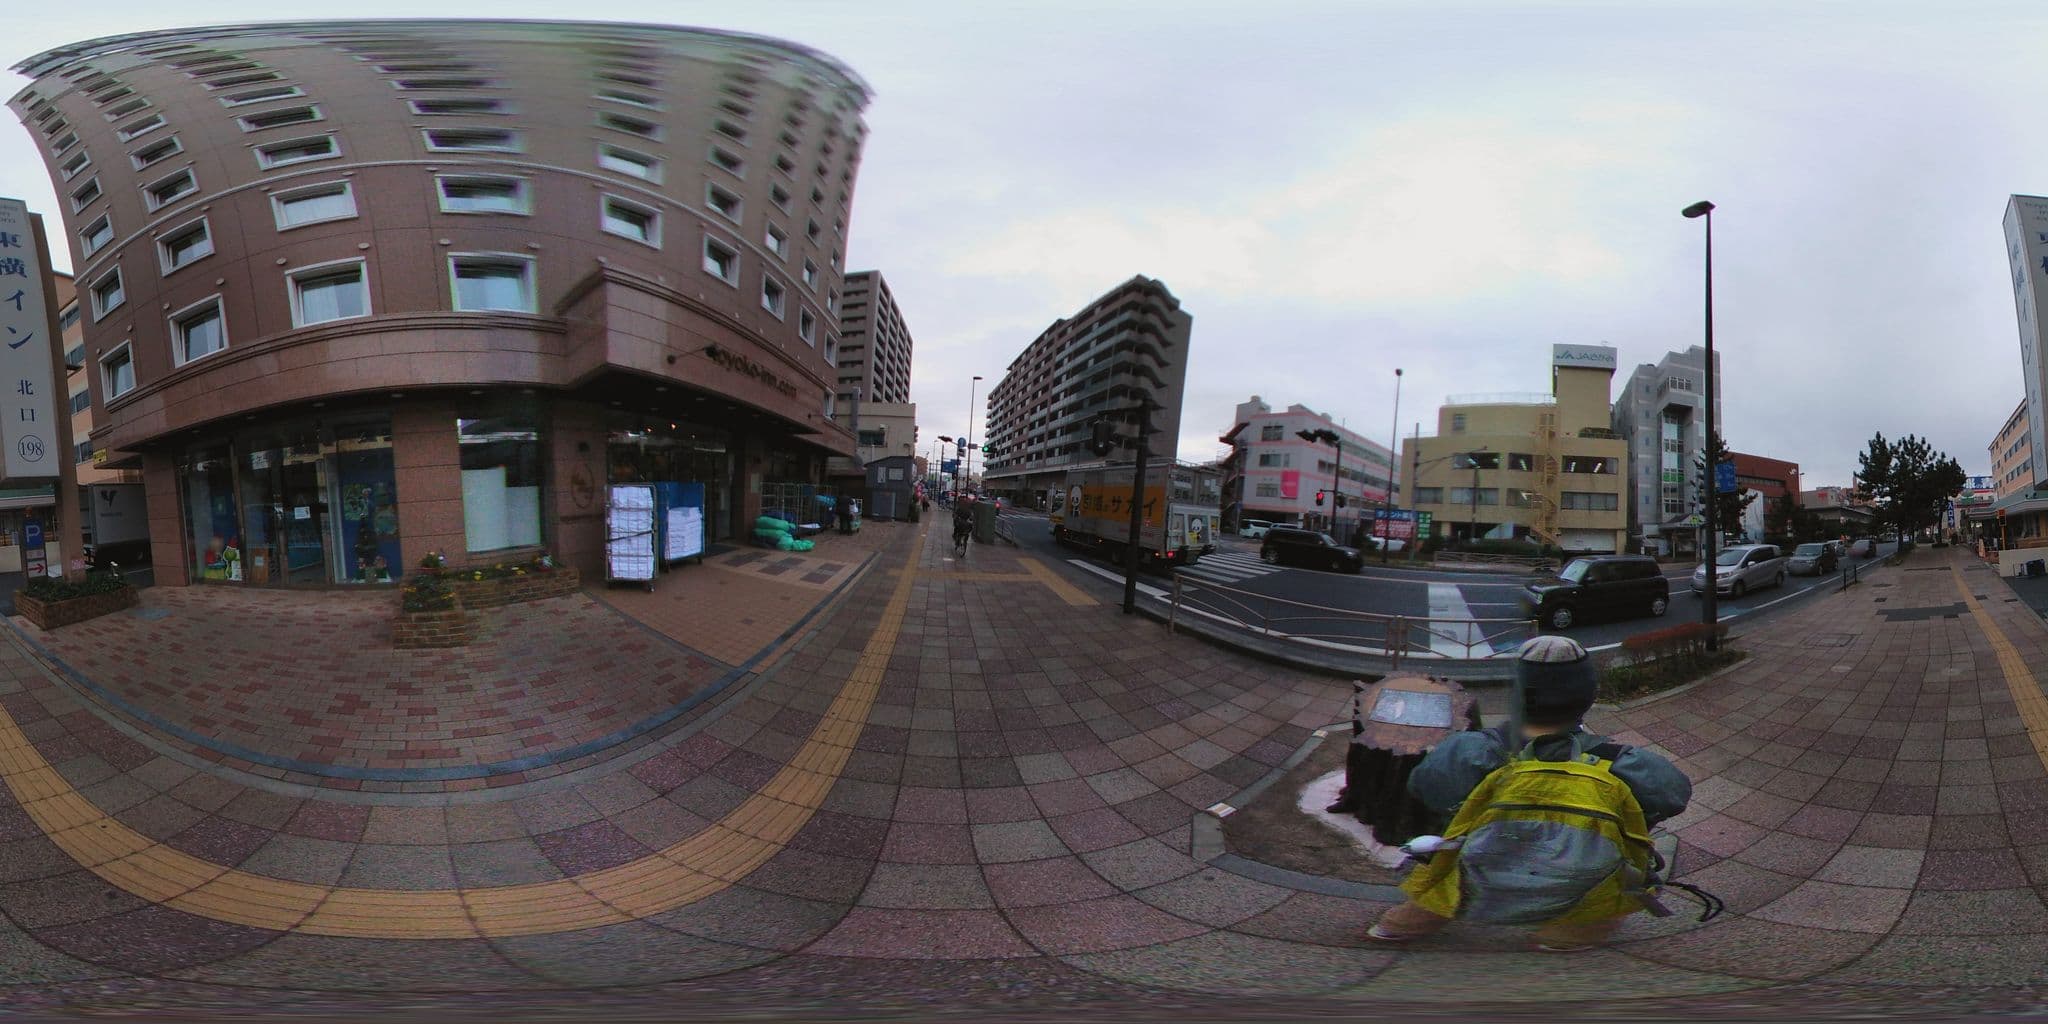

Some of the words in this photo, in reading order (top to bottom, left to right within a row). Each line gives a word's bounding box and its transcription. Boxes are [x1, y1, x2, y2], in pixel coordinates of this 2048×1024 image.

[18, 379, 35, 422] 北口
[20, 440, 43, 457] 198
[26, 525, 41, 543] P
